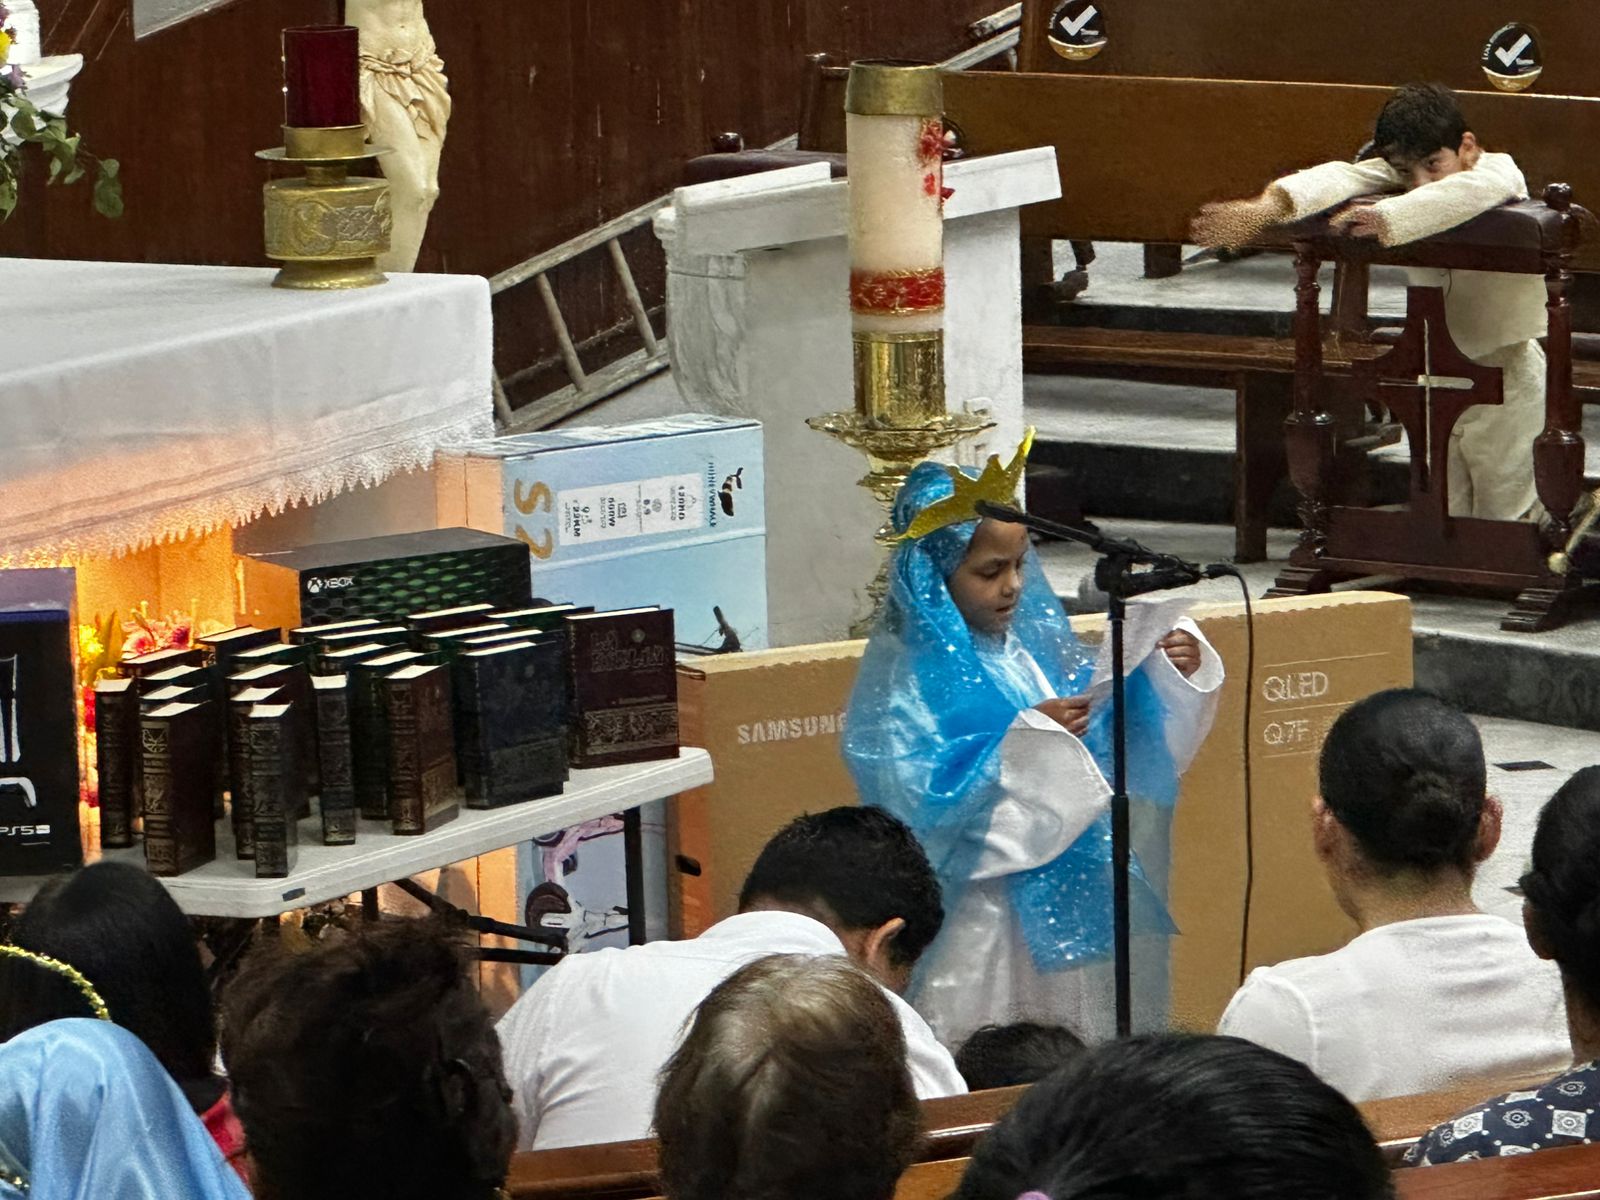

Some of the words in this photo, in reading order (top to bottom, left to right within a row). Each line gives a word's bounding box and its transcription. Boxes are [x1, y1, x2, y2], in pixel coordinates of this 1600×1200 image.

[323, 576, 355, 589] XBOX
[1263, 672, 1328, 701] QLED
[1264, 721, 1309, 744] Q7F
